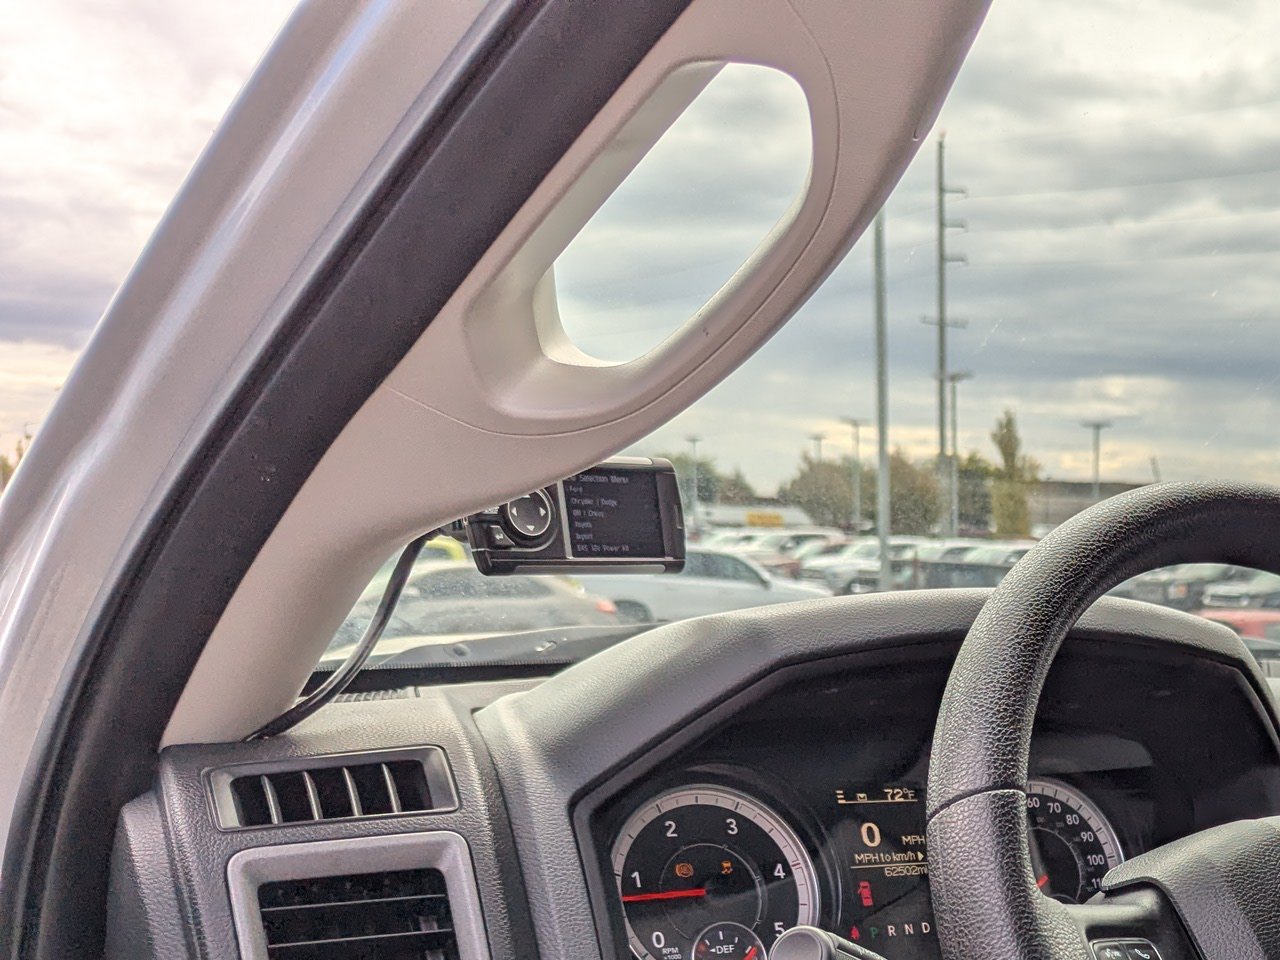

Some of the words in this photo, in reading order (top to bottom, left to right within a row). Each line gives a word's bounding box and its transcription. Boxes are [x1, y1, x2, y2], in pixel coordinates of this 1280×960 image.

[1026, 797, 1040, 808] 60
[1047, 802, 1062, 814] 70
[725, 818, 738, 835] 3
[1066, 814, 1080, 825] 80
[664, 821, 678, 838] 2
[861, 822, 881, 848] 0
[1080, 831, 1094, 842] 90
[901, 835, 925, 846] MPH
[1087, 855, 1105, 866] 100
[773, 863, 786, 879] 4
[631, 871, 642, 888] 1
[773, 921, 786, 937] 5
[887, 925, 897, 937] R
[904, 923, 915, 935] N
[921, 922, 931, 934] D
[652, 931, 665, 948] 0
[716, 944, 735, 955] DEF
